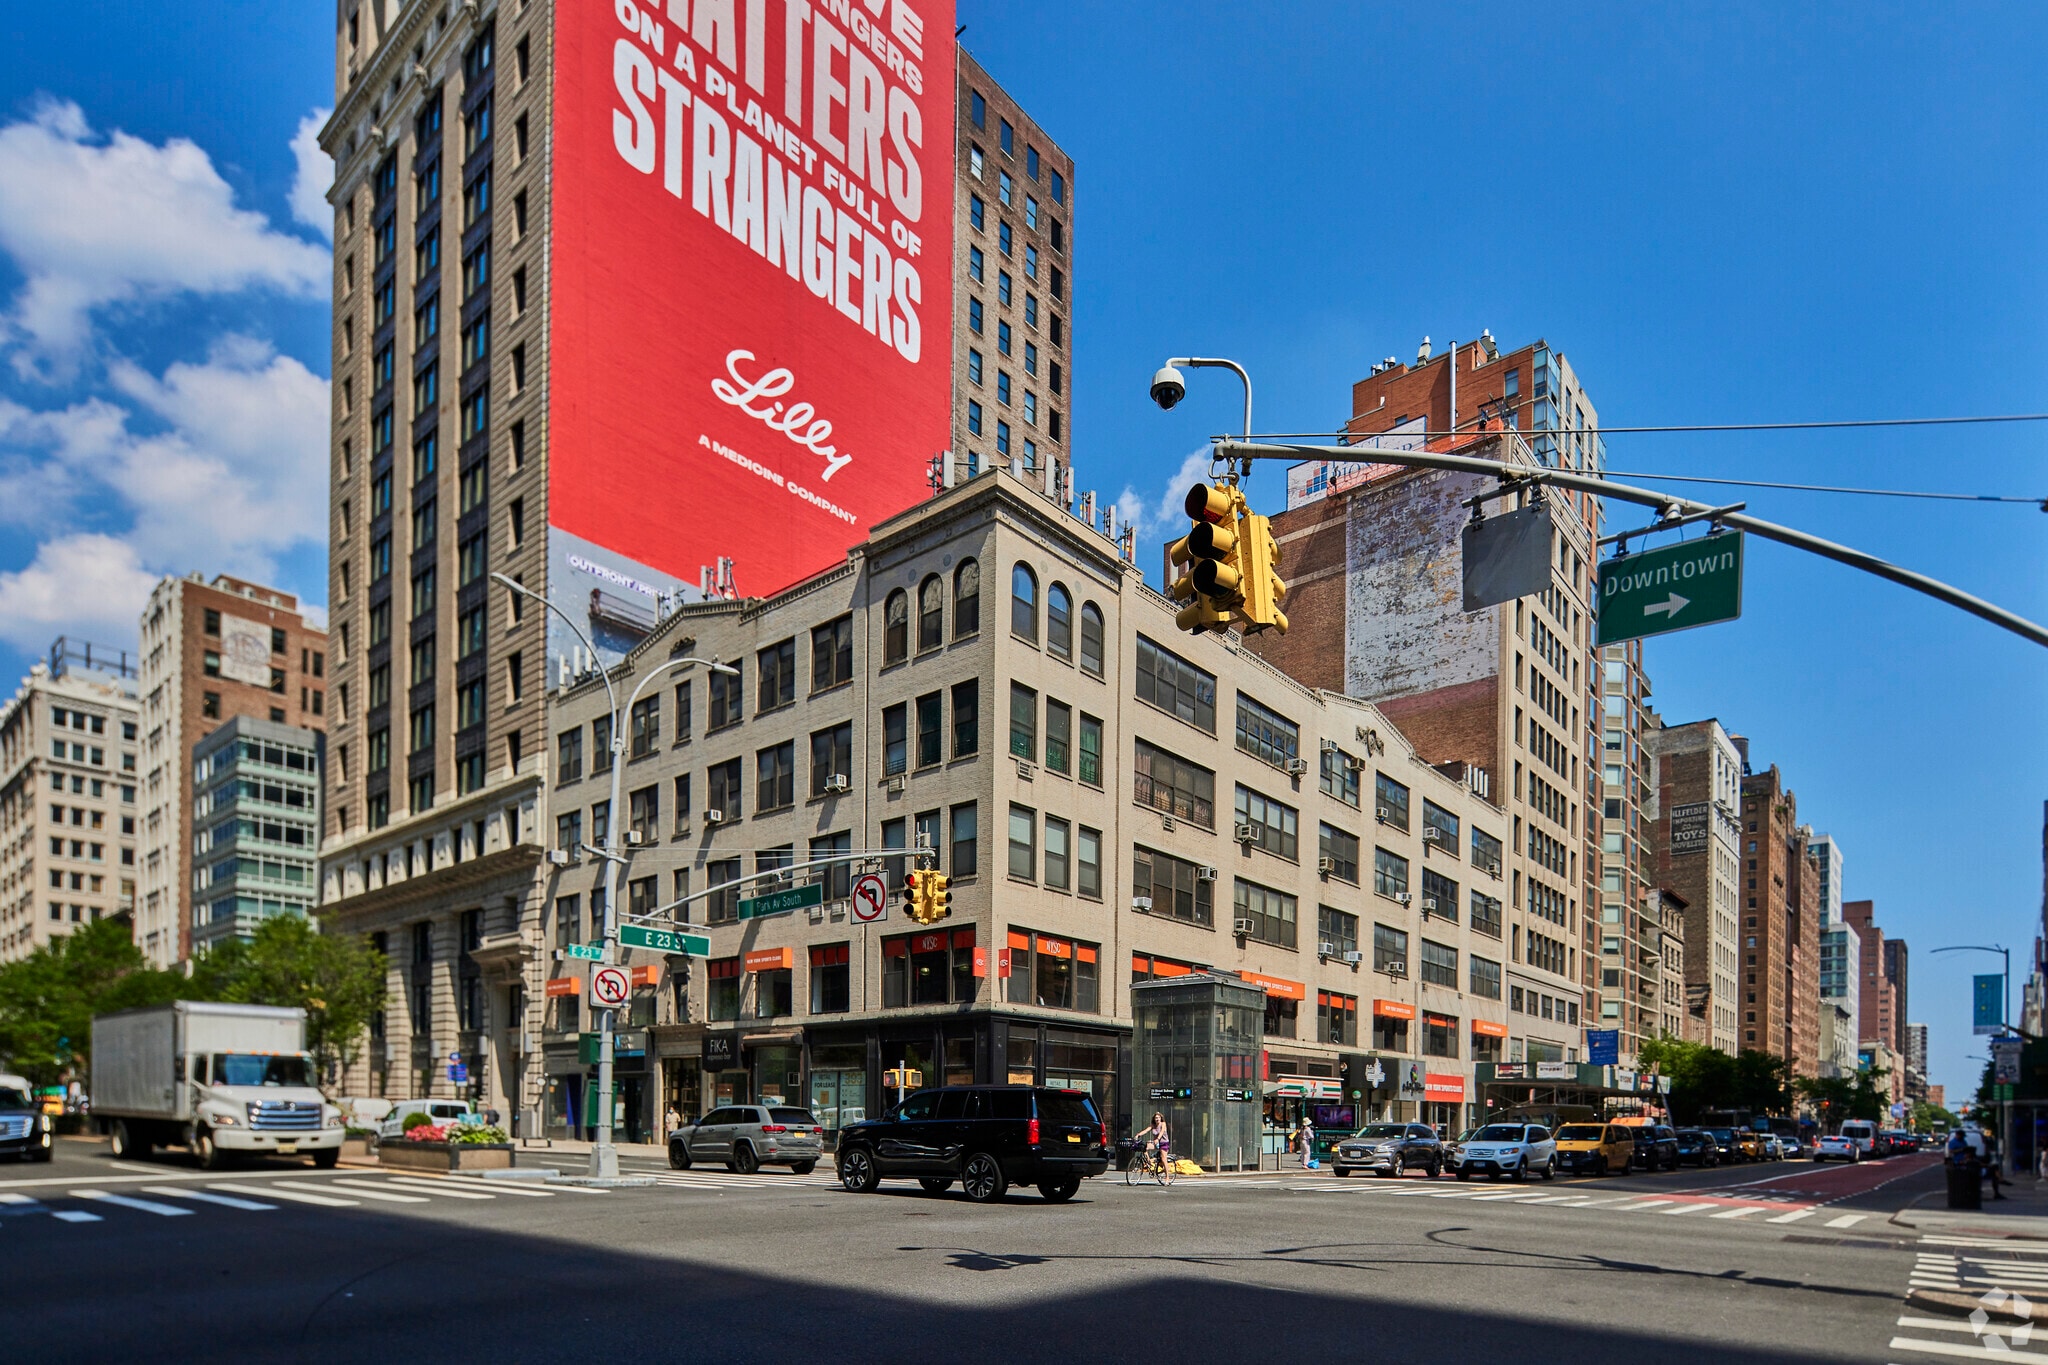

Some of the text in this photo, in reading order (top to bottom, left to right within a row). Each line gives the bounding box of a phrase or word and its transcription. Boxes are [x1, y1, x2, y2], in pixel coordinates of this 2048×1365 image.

[614, 0, 921, 257] ON A PLANET FULL OF
[613, 38, 921, 364] STRANGERS
[711, 349, 852, 483] Lilly
[699, 434, 857, 525] A MEDICINE COMPANY
[1605, 551, 1734, 597] Downtown
[1674, 829, 1707, 842] TOYS
[756, 893, 802, 912] Park Av South
[645, 931, 687, 950] E 23 St
[922, 936, 938, 951] NYSC
[1046, 940, 1061, 954] NYSC
[571, 947, 578, 955] E
[581, 947, 592, 958] 23
[709, 1039, 729, 1053] FIKA
